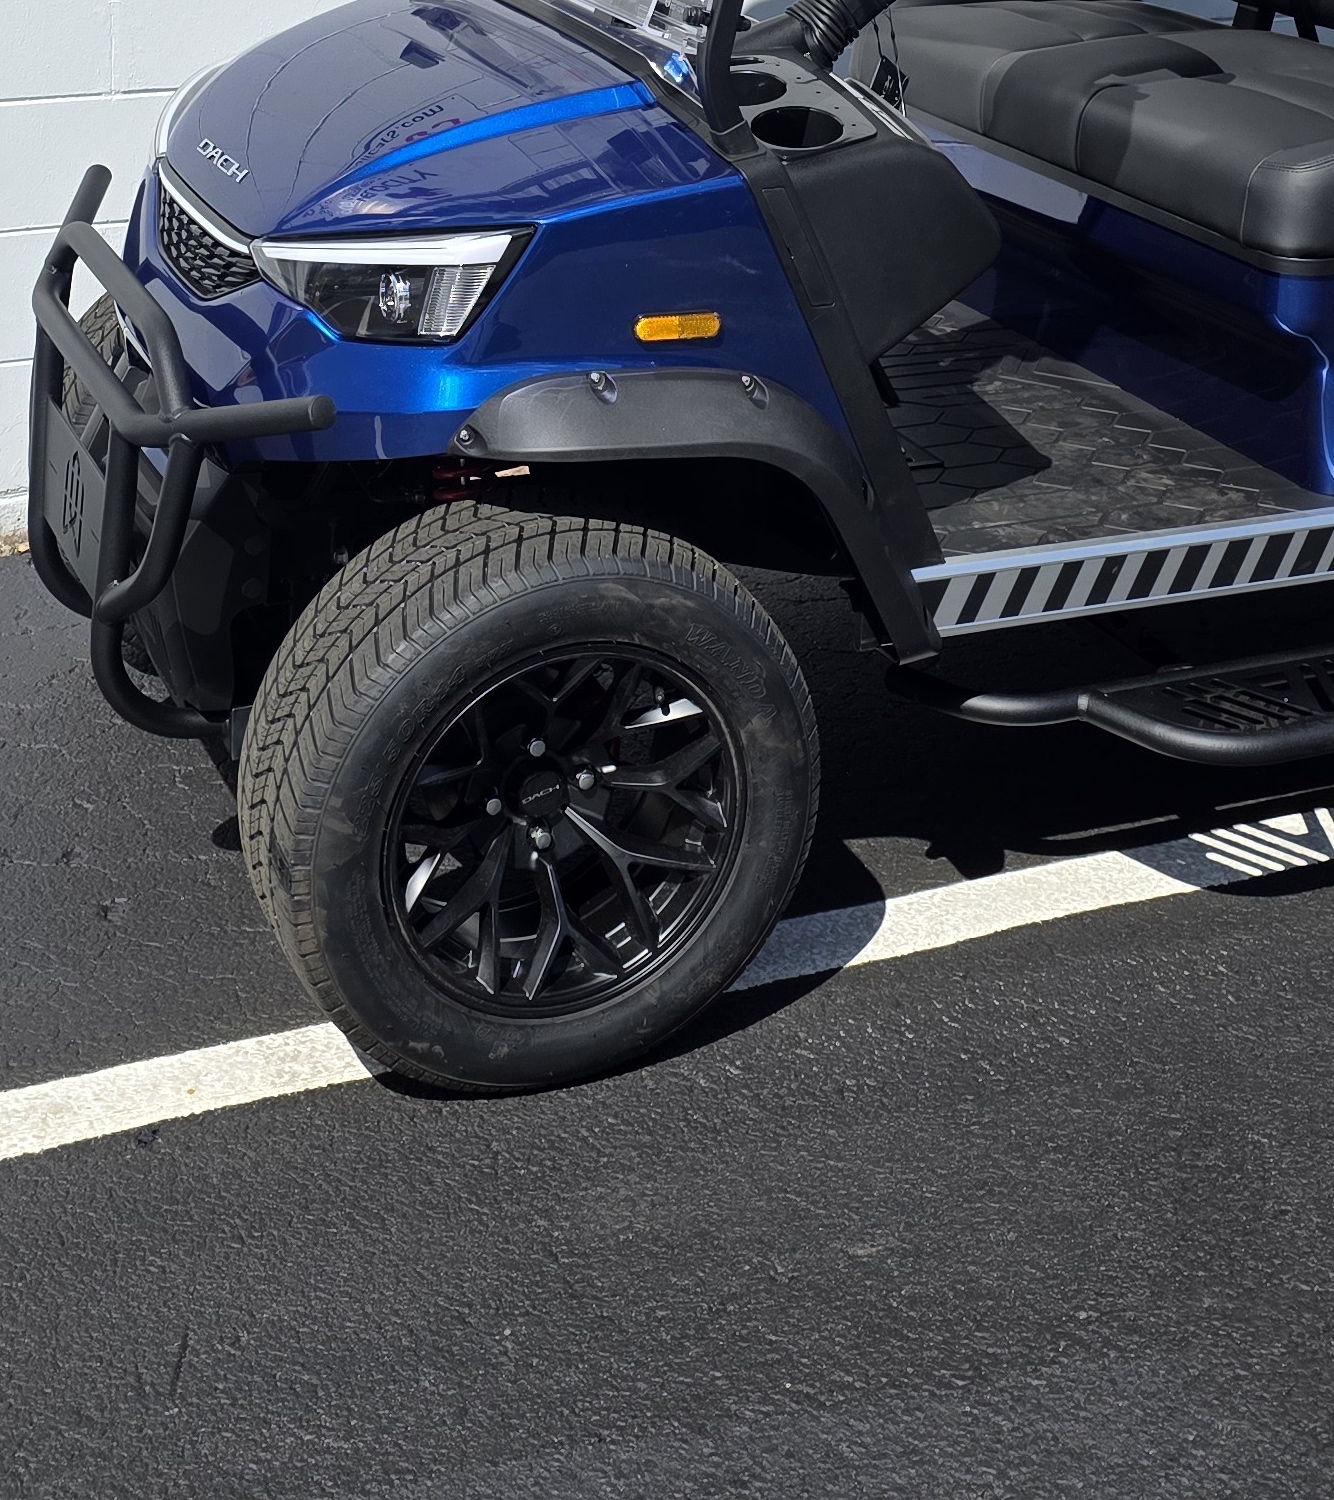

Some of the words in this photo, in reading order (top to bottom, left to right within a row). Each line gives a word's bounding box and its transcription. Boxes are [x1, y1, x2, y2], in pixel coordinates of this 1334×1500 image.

[196, 138, 249, 183] DACH
[685, 622, 778, 722] WANDA
[522, 784, 560, 805] DACH
